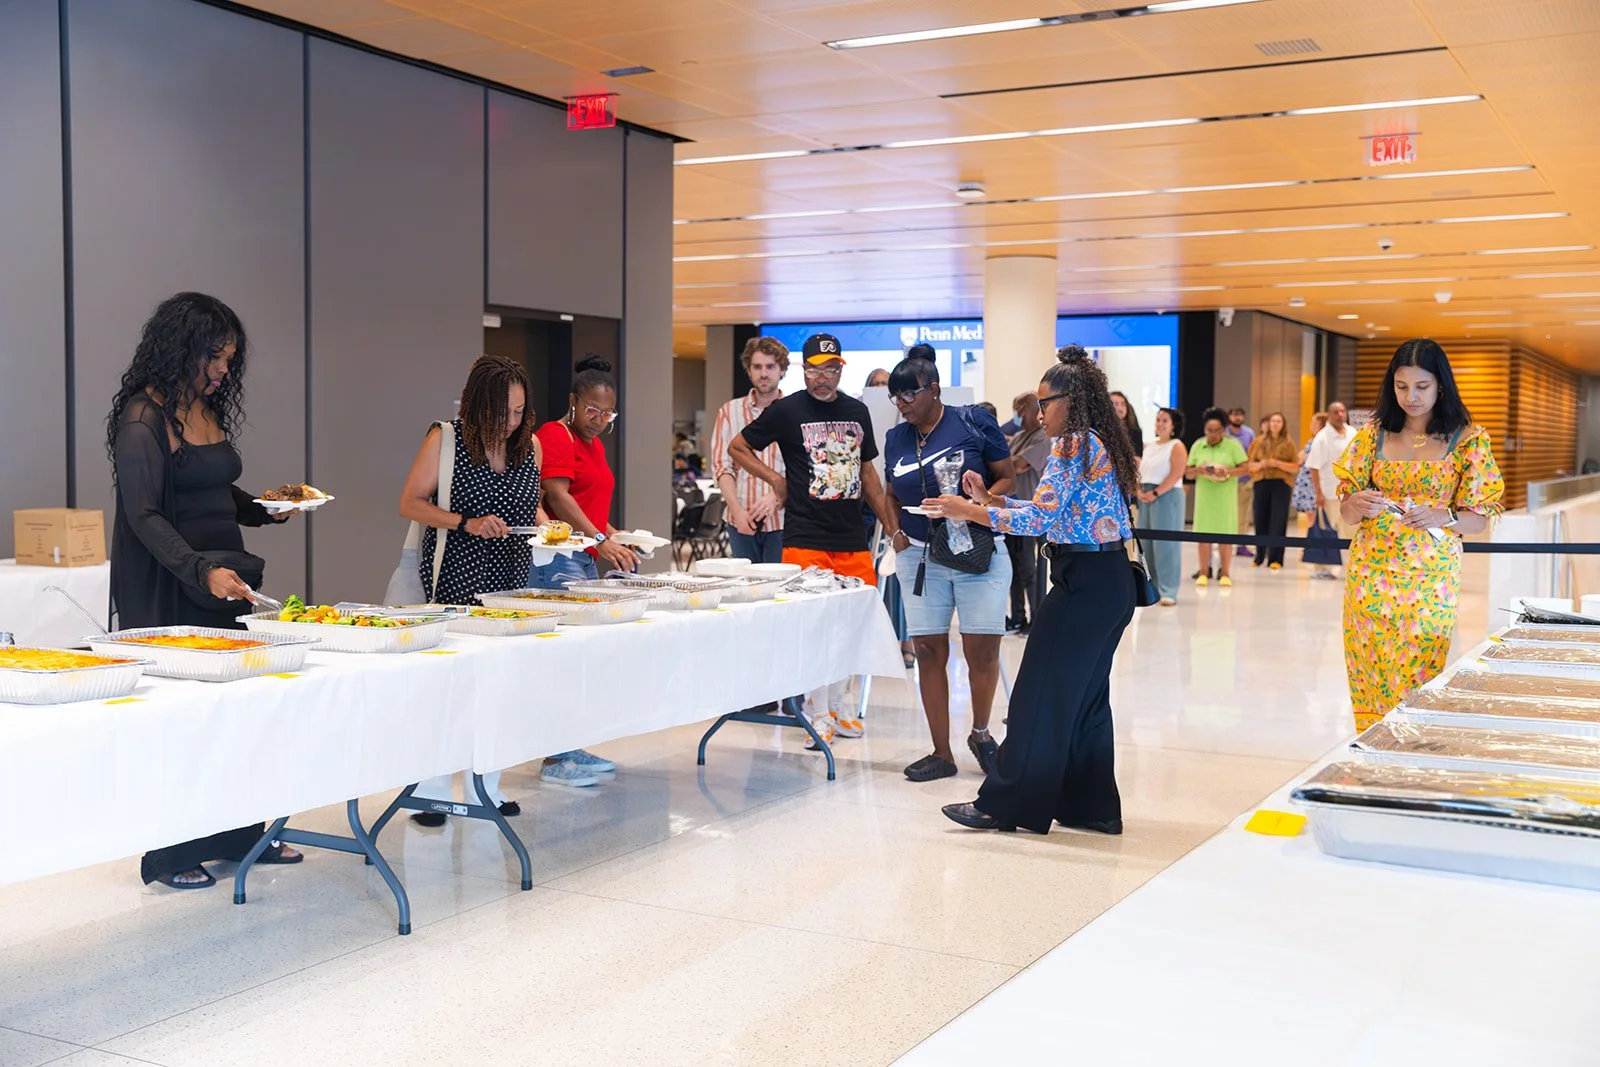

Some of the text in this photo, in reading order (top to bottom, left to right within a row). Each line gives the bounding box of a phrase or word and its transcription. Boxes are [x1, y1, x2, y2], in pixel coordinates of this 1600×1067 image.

[577, 96, 608, 124] EXIT
[1372, 136, 1409, 162] EXIT
[920, 323, 984, 341] Penn Med
